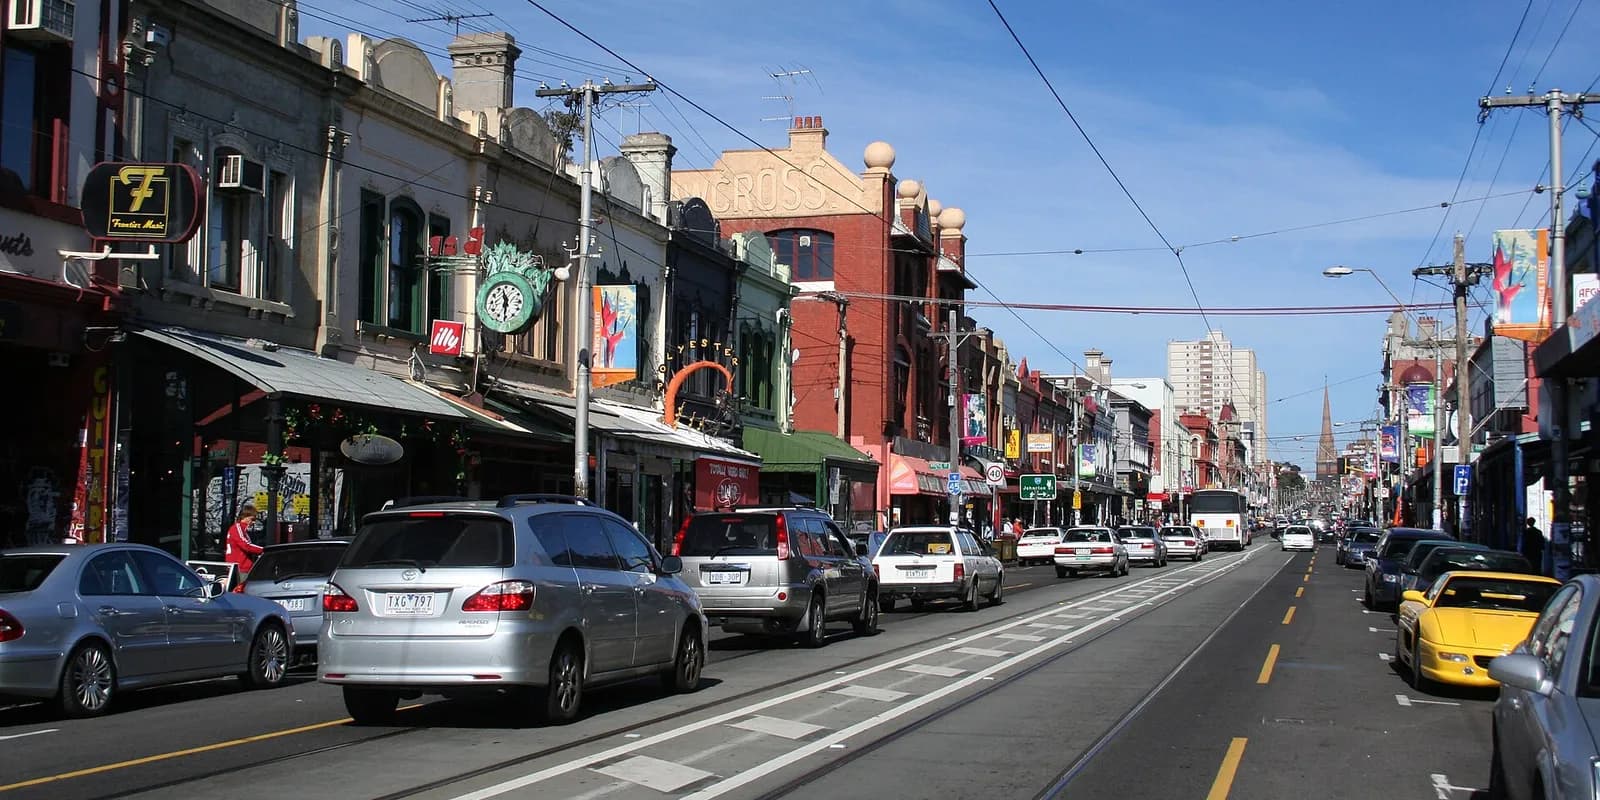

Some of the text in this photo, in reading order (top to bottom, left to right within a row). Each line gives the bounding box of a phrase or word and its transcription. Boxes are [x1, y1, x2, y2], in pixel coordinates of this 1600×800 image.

[433, 327, 459, 352] illy
[657, 338, 740, 391] POLYESTER
[989, 469, 1001, 478] 40
[389, 595, 433, 608] TXG 797
